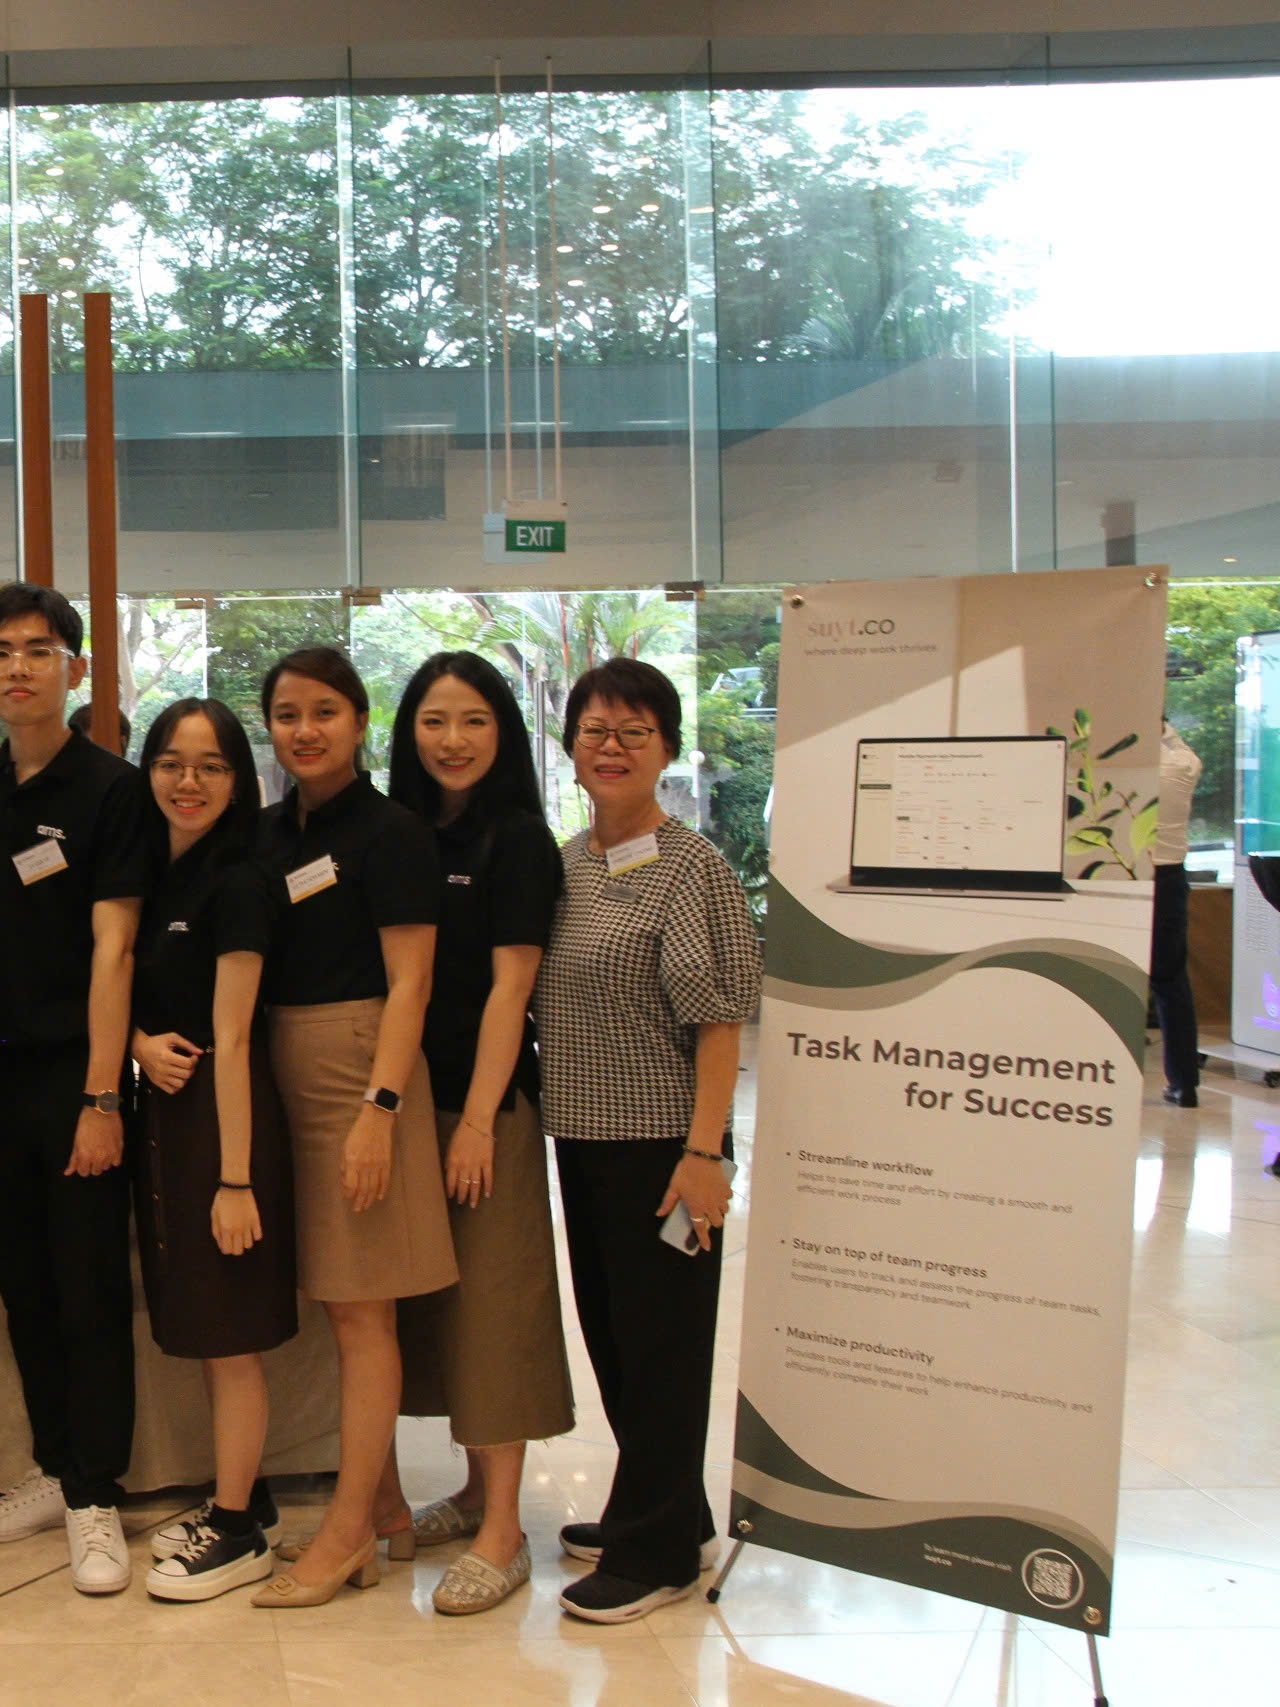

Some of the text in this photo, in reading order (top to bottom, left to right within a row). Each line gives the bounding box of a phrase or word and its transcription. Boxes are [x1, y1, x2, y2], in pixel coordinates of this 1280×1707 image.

[516, 525, 554, 547] EXIT
[787, 1032, 1117, 1084] Task Management
[903, 1081, 1113, 1127] for Success
[798, 1149, 934, 1177] Streamline workflow
[792, 1238, 987, 1278] Stay on top of team progress
[786, 1325, 934, 1366] Maximize productivity
